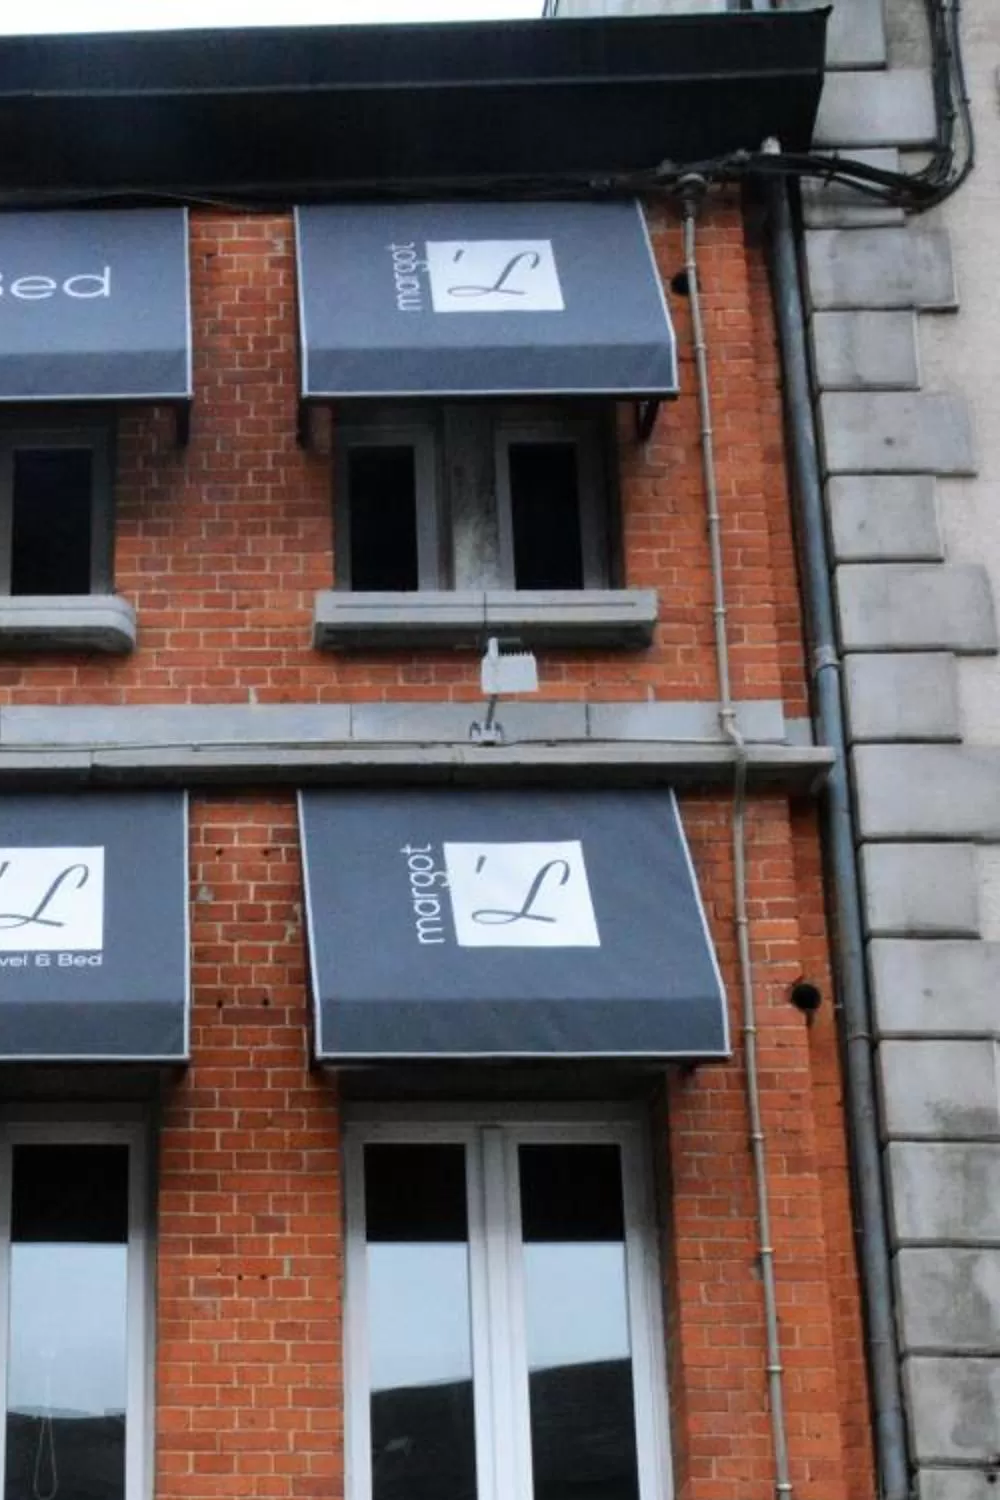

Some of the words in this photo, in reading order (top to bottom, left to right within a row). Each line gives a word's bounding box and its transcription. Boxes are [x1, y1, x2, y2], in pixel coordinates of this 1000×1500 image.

[385, 242, 429, 311] margot
[401, 842, 450, 944] margot
[58, 953, 103, 967] Bed
